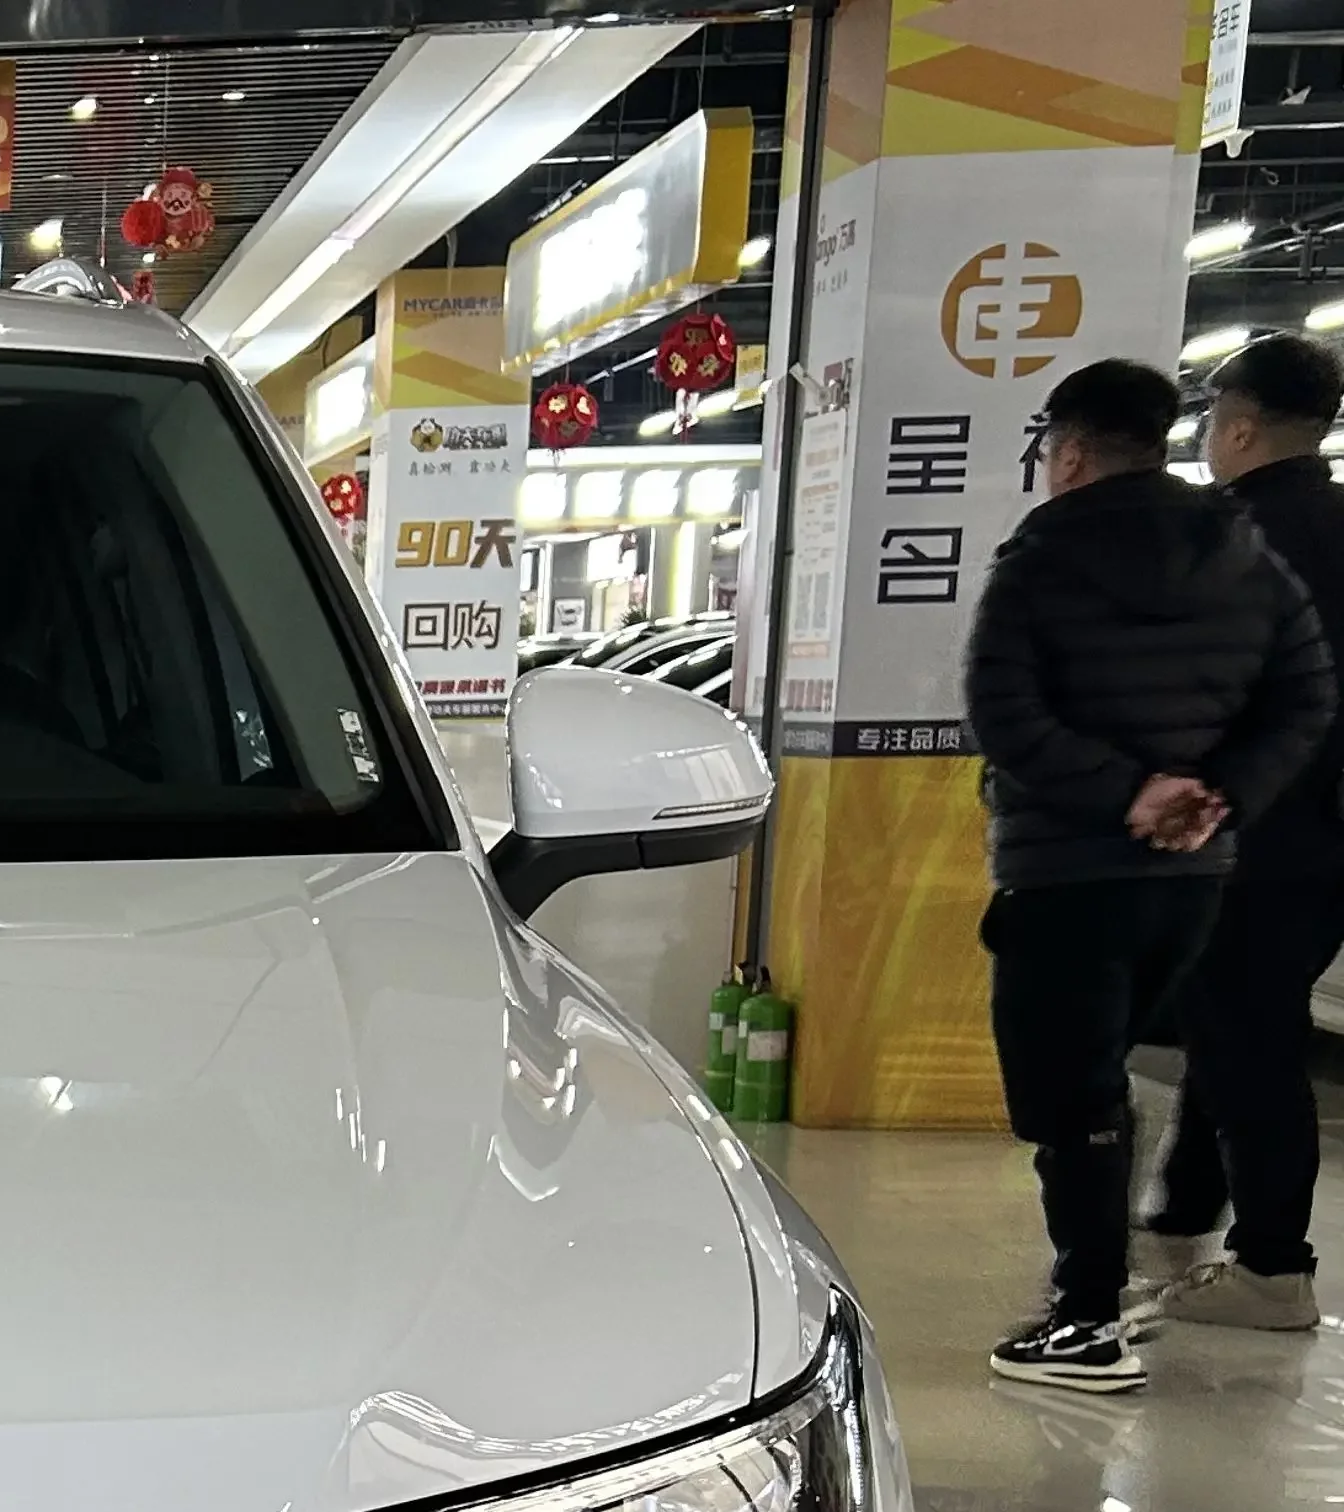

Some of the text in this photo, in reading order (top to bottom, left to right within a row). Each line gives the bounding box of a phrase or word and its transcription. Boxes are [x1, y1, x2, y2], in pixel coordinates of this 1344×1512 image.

[395, 518, 517, 568] 90天
[403, 600, 502, 650] 回购
[857, 728, 961, 751] 专注品质
